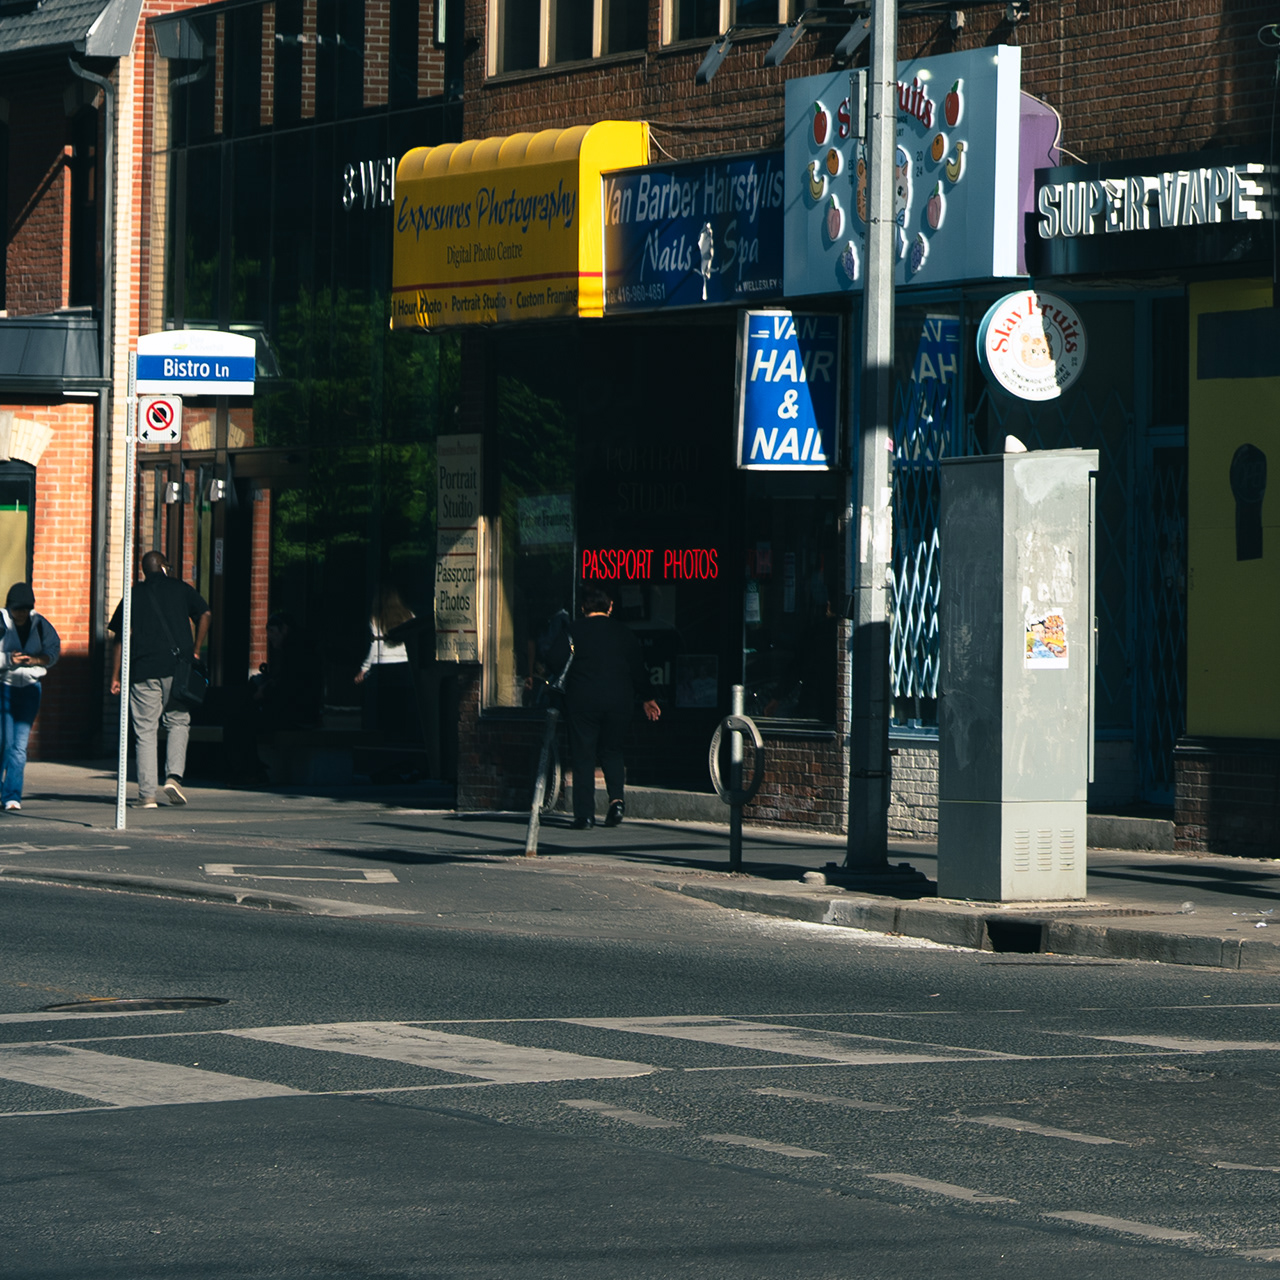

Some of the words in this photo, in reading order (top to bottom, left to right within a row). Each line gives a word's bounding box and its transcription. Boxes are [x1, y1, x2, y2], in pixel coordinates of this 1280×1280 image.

[396, 195, 471, 242] Exposures
[476, 178, 577, 233] Photography
[604, 178, 632, 226] Van
[635, 171, 700, 222] Barber
[1038, 176, 1151, 239] SUPER
[1158, 162, 1265, 228] VAPE
[446, 244, 473, 266] Digital
[473, 241, 496, 264] Photo
[497, 239, 523, 261] Centre
[639, 228, 693, 282] Nails
[720, 219, 759, 282] Spa
[398, 298, 419, 316] Hour
[419, 296, 442, 314] Photo
[451, 293, 479, 312] Portrait
[481, 290, 507, 310] Studio
[516, 289, 545, 309] Custom
[546, 285, 578, 308] Framing
[741, 278, 778, 293] WELLESLEY
[773, 317, 818, 340] VAN
[991, 307, 1023, 353] Slay
[1027, 295, 1080, 354] Fruits
[163, 358, 210, 378] Bistro
[215, 363, 229, 378] Ln
[750, 349, 834, 383] HAIR
[777, 389, 799, 419] &
[749, 427, 829, 461] NAIL
[440, 466, 477, 490] Portrait
[443, 494, 474, 518] Studio
[437, 562, 475, 588] Passport
[582, 549, 654, 579] PASSPORT
[664, 548, 718, 580] PHOTOS
[440, 590, 470, 610] Photos
